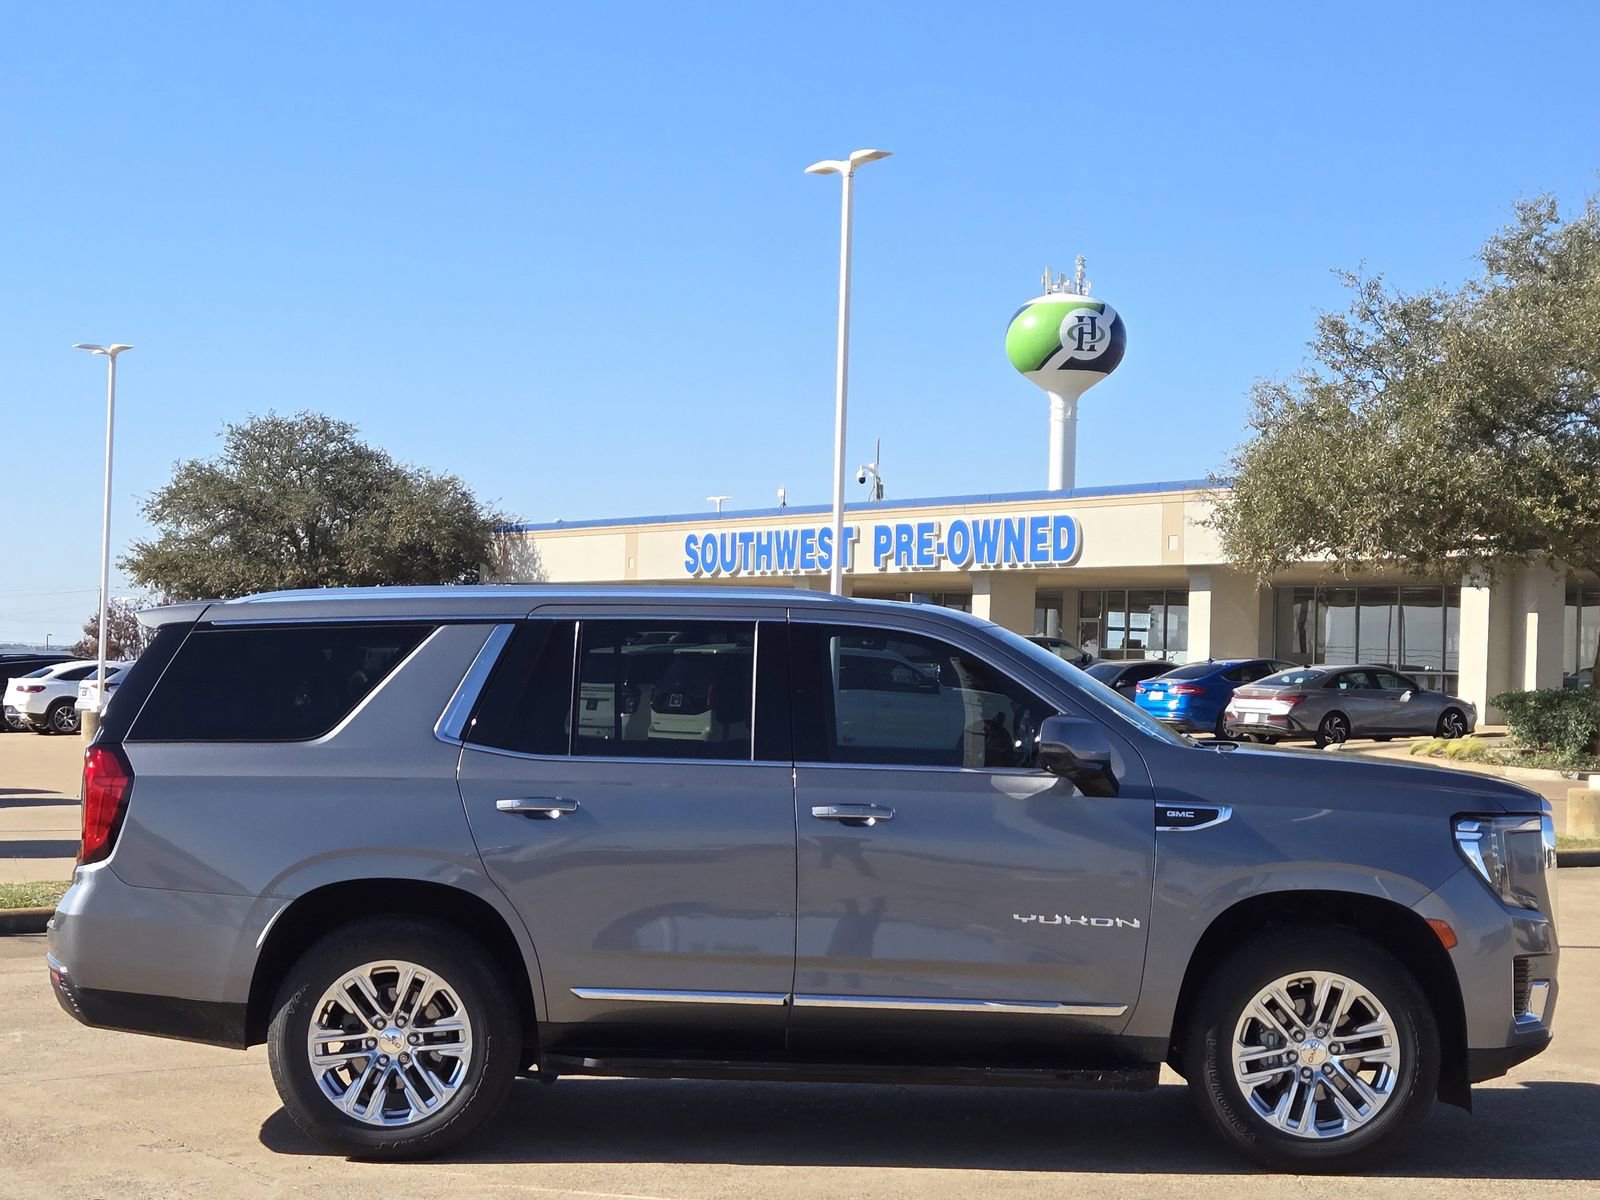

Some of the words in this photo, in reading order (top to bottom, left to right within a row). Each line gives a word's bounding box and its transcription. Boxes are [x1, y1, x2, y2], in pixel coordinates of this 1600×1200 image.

[684, 525, 857, 575] SOUTHWEST
[873, 514, 1081, 569] PRE-OWNED
[1166, 810, 1195, 818] GMC
[1012, 913, 1141, 929] YUKON
